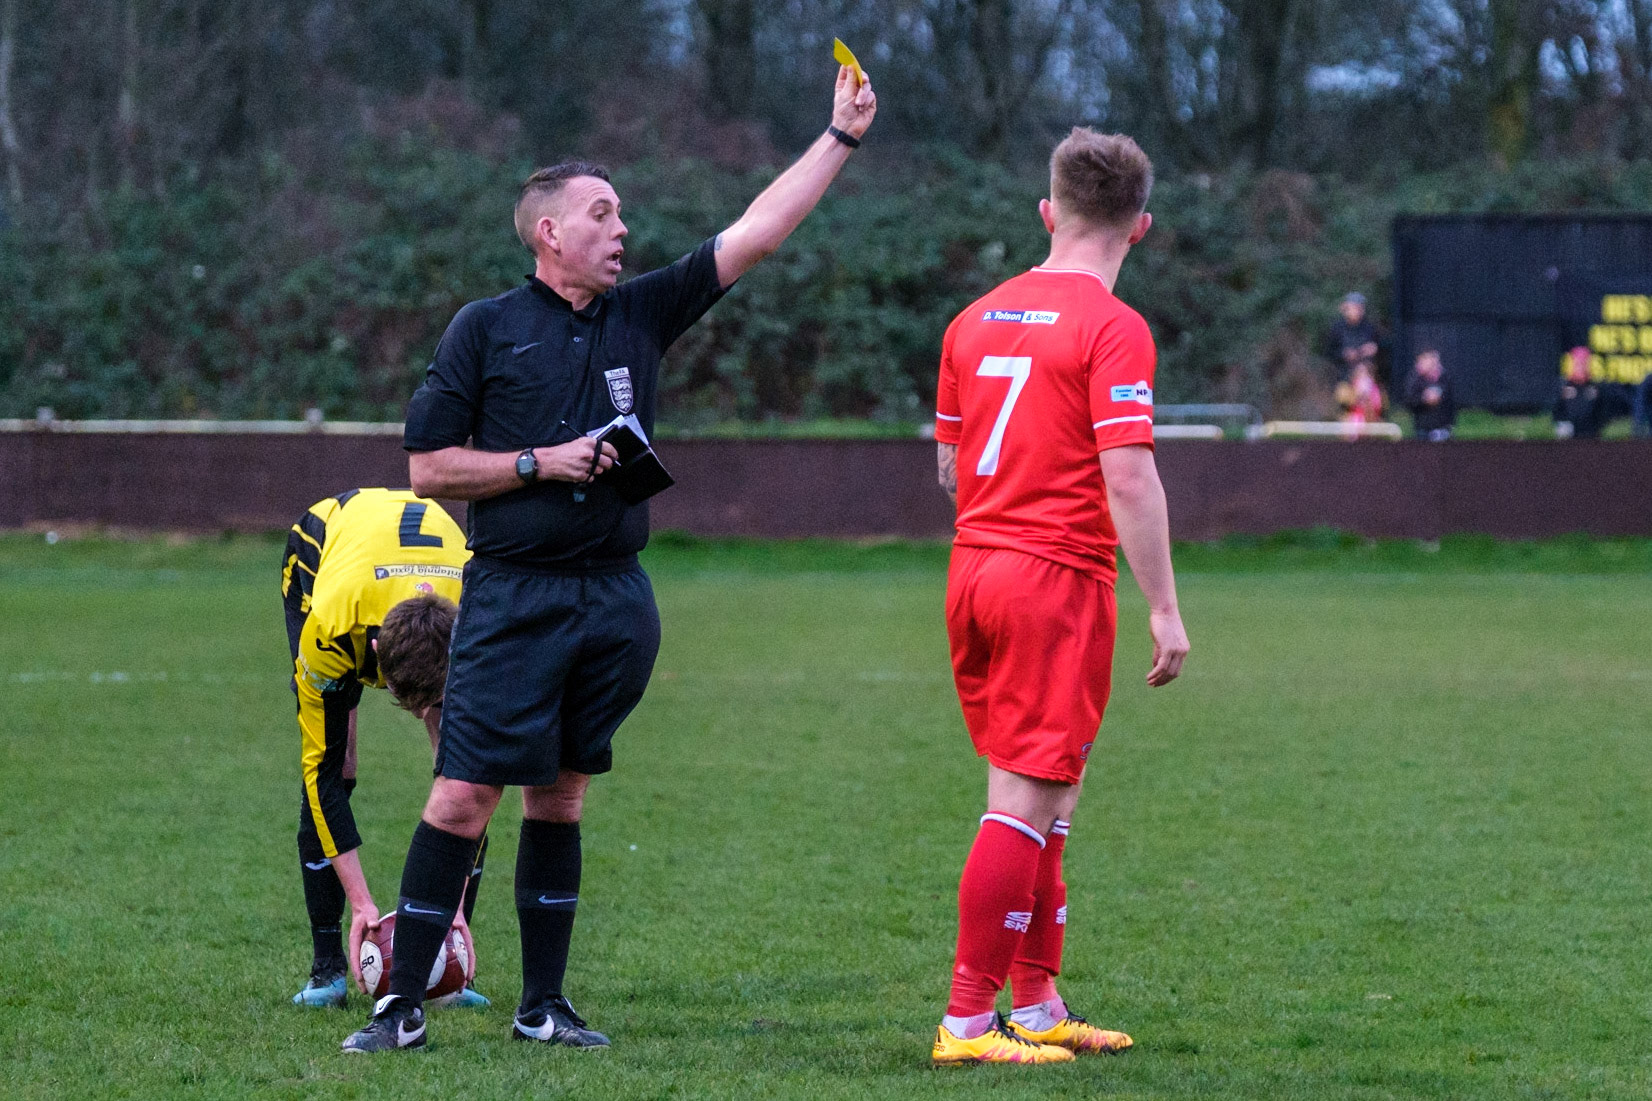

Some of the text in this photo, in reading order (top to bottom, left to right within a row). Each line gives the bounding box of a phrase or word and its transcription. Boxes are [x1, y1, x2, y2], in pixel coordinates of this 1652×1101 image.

[983, 311, 1053, 322] D. Tolson & Sons
[976, 355, 1032, 476] 7
[399, 502, 443, 548] 7
[390, 567, 415, 575] Taxis
